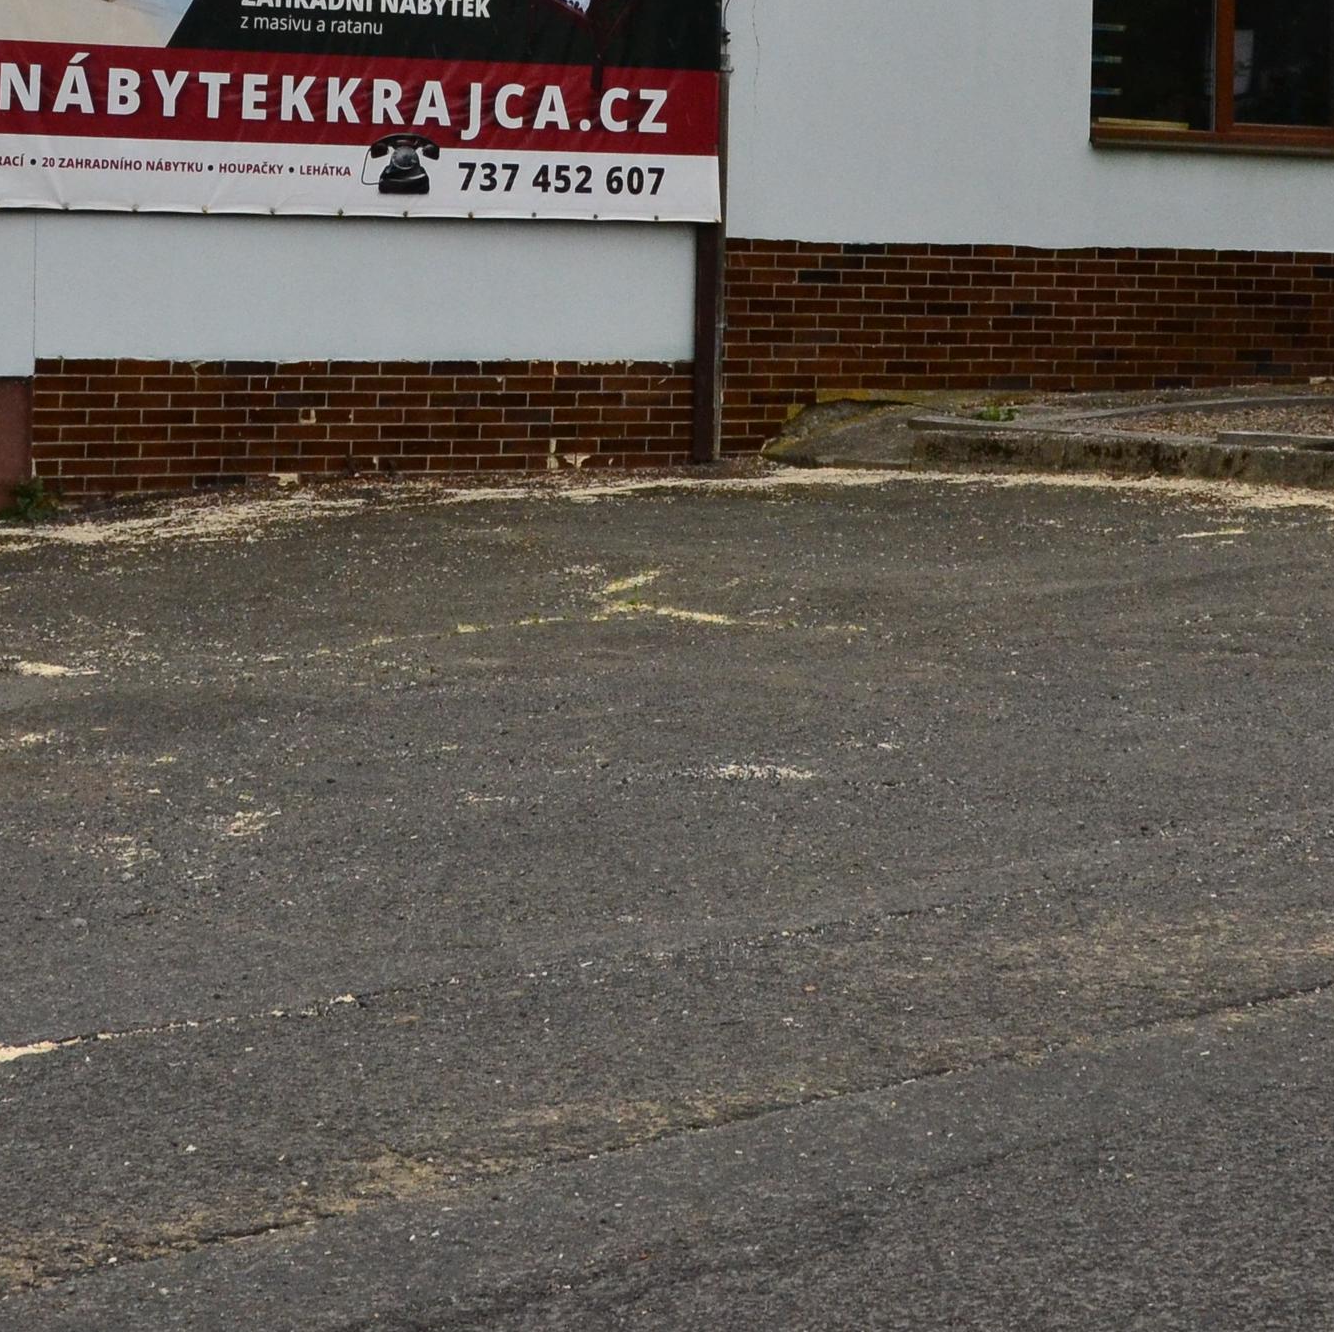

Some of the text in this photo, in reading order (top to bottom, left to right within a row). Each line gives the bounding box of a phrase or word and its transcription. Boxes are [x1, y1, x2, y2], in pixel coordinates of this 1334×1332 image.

[240, 14, 383, 34] z masivu a ratanu
[41, 157, 55, 168] 20
[58, 157, 142, 171] ZAHRADNÍHO
[146, 158, 203, 173] NÁBYTKU
[218, 159, 284, 175] HOUPAČKY
[299, 162, 351, 177] LEHÁTKA
[458, 162, 666, 195] 737 452 607
